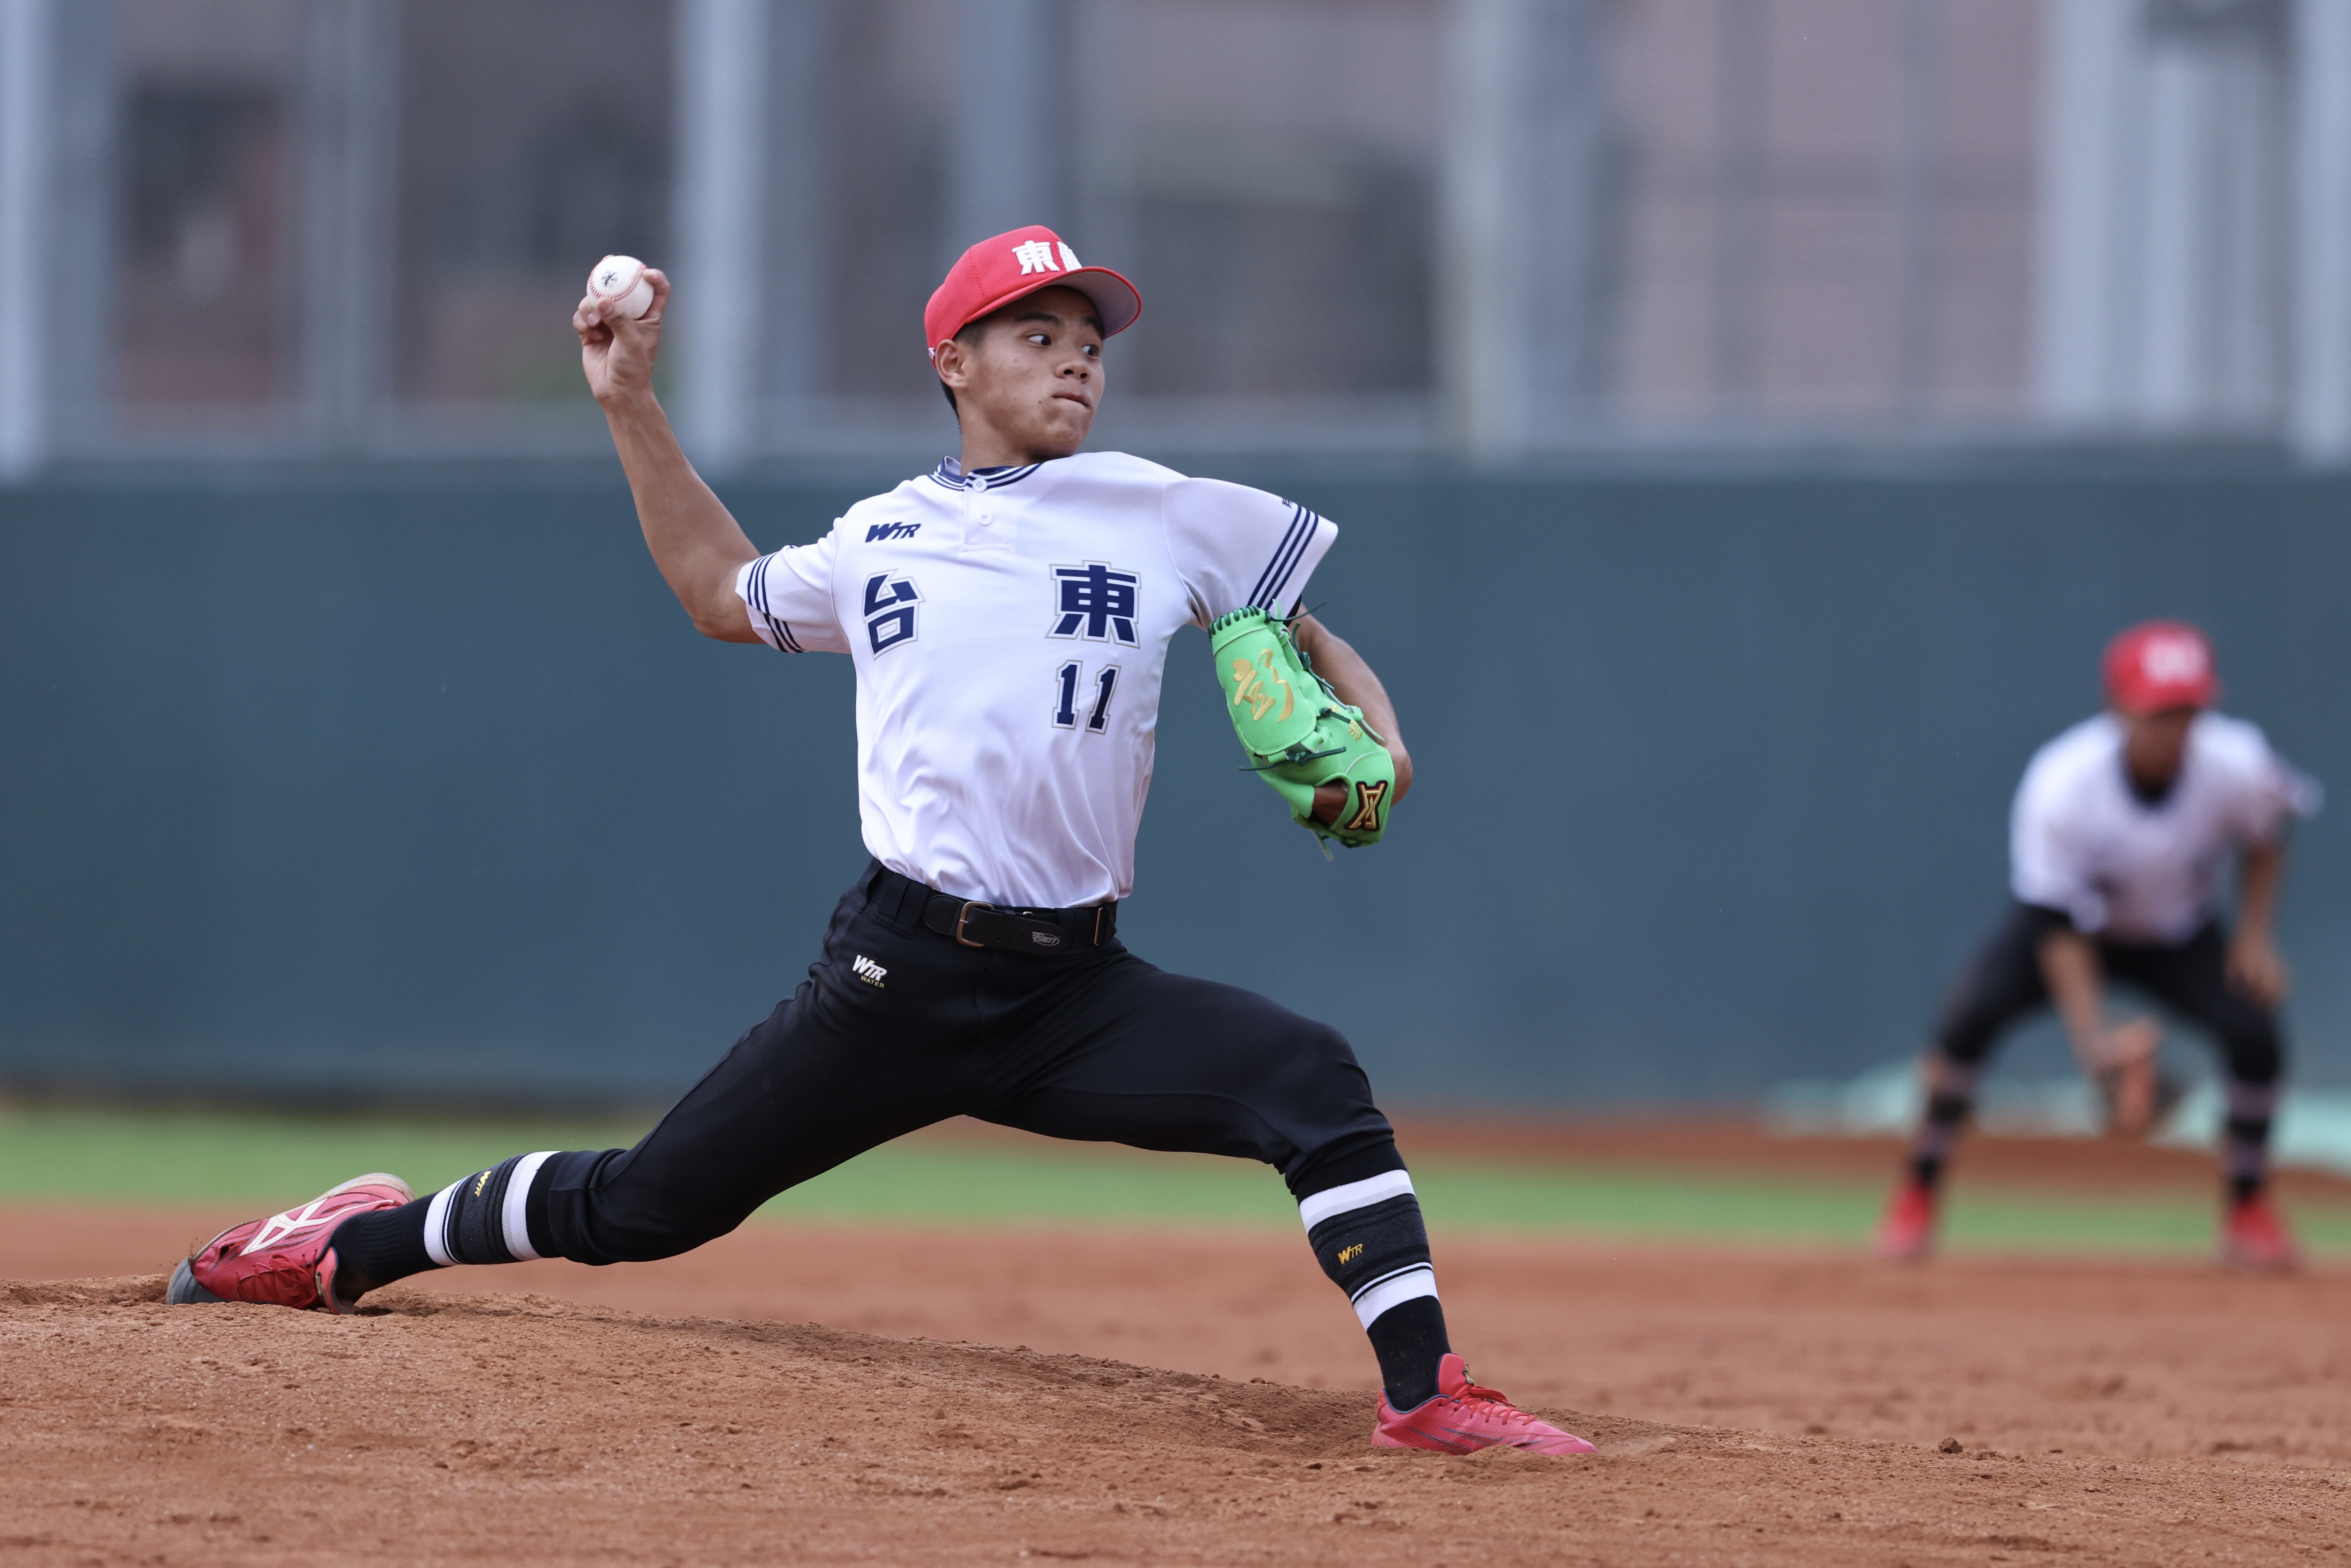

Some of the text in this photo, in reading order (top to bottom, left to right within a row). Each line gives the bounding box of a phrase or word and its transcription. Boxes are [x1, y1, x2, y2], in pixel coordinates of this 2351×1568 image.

[864, 521, 921, 543] WTR
[862, 559, 1142, 661] 台 東
[1051, 659, 1122, 735] 11
[852, 954, 888, 981] WTR
[861, 975, 885, 988] WATER
[475, 1170, 492, 1197] WTR
[1337, 1243, 1363, 1265] WTR
